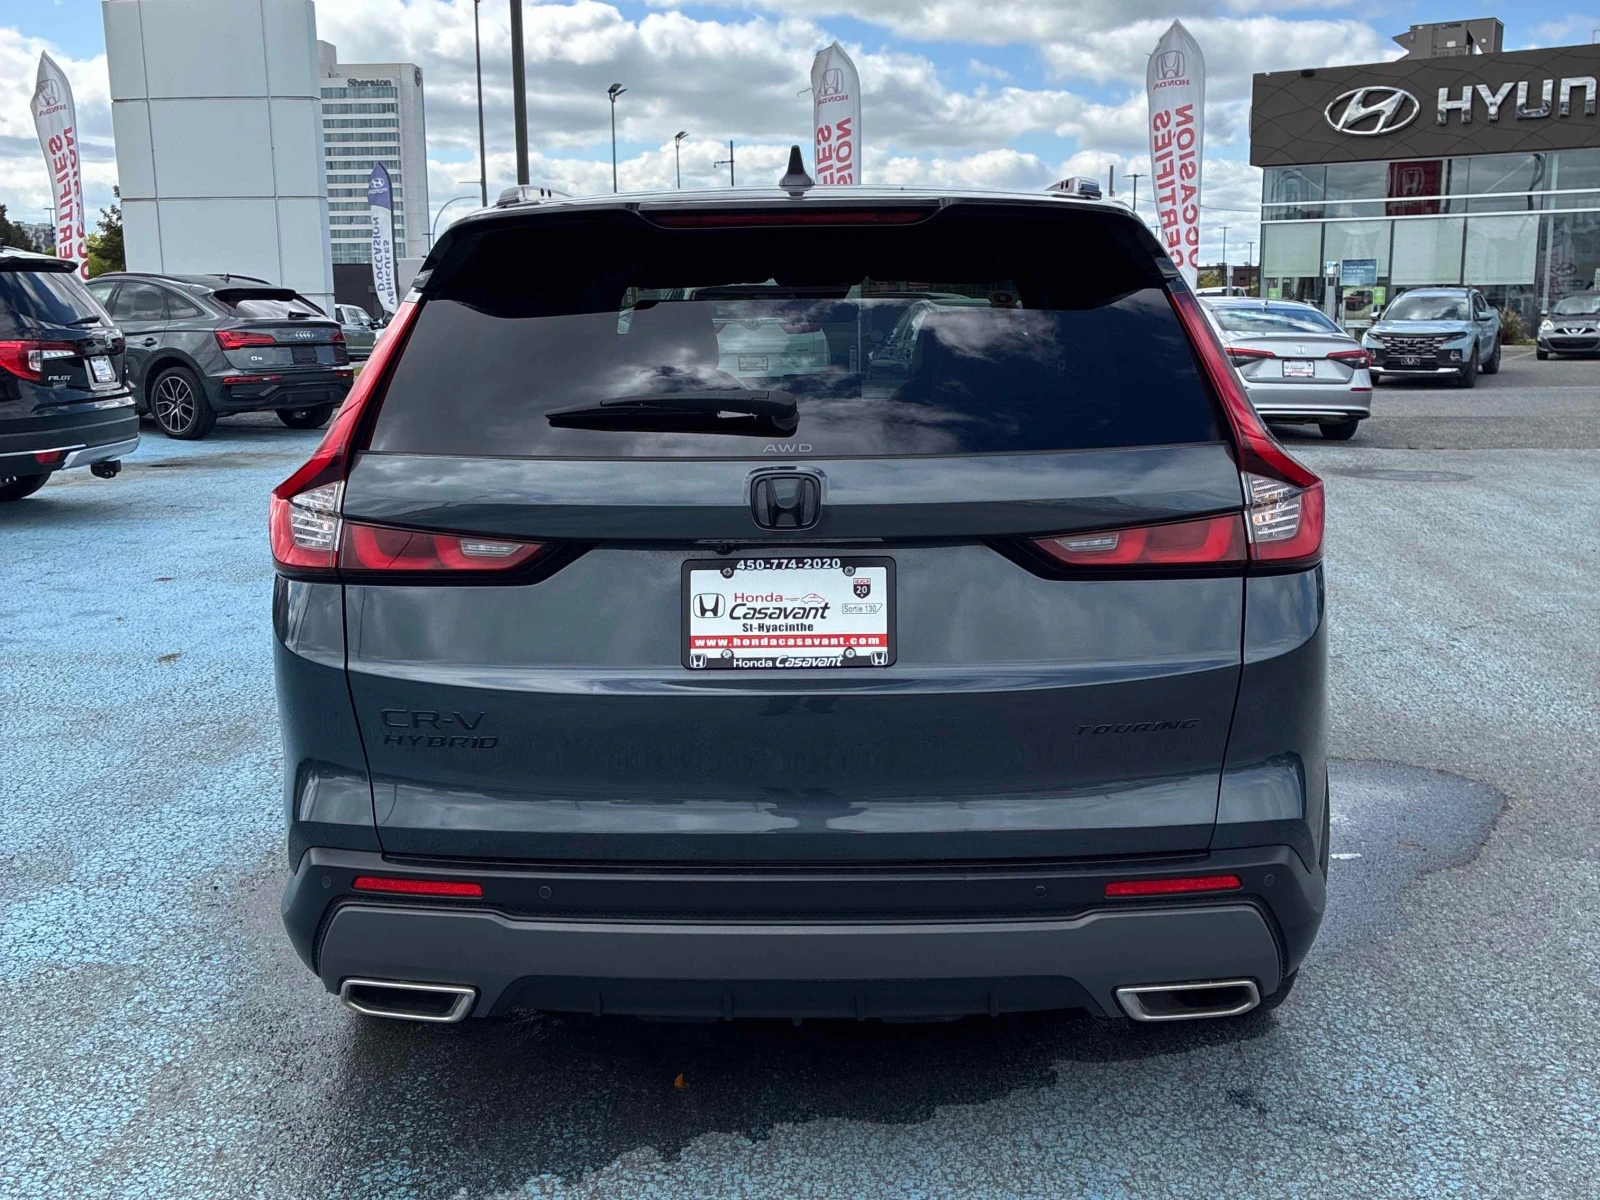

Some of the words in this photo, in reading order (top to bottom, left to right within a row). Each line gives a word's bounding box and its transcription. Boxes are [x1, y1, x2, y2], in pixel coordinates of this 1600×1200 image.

[347, 78, 392, 87] Sheraton
[763, 443, 813, 453] AWD
[737, 558, 841, 570] 450-774-2020
[855, 585, 868, 594] 20
[733, 592, 784, 603] Honda
[729, 602, 831, 620] Casavant
[843, 604, 863, 613] Sortie
[864, 604, 877, 613] 130
[742, 622, 814, 633] St-Hyacinthe
[694, 636, 880, 647] www.hondacasavant.com
[733, 658, 773, 668] Honda
[775, 655, 843, 668] Casavant
[381, 708, 486, 731] CR-V
[1076, 718, 1202, 735] TOURING
[383, 733, 499, 749] HYBRID
